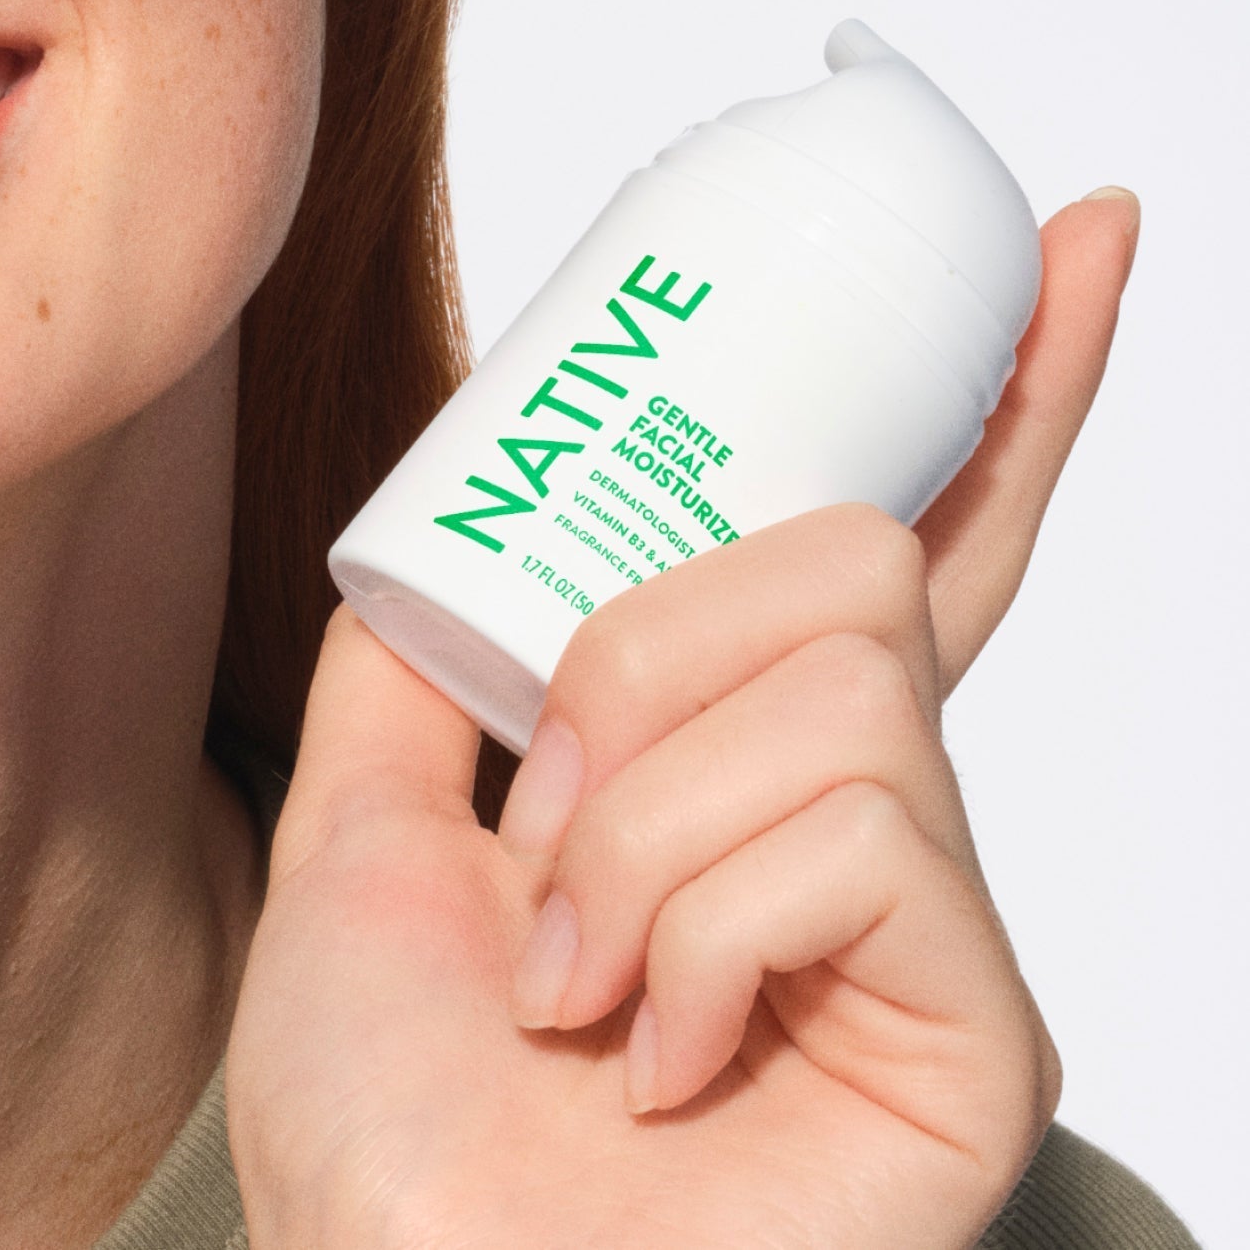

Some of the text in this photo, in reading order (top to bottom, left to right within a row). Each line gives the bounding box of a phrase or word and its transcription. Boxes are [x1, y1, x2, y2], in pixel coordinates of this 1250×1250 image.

[432, 254, 714, 555] NATIVE
[647, 395, 734, 468] GENTLE
[628, 414, 706, 483] FACIAL
[553, 513, 628, 574] FRAGRANCE
[573, 490, 673, 573] VITAMIN B3 & A
[588, 469, 696, 559] DERMATOLOGIST
[521, 554, 595, 616] 1.7 FL OZ (50
